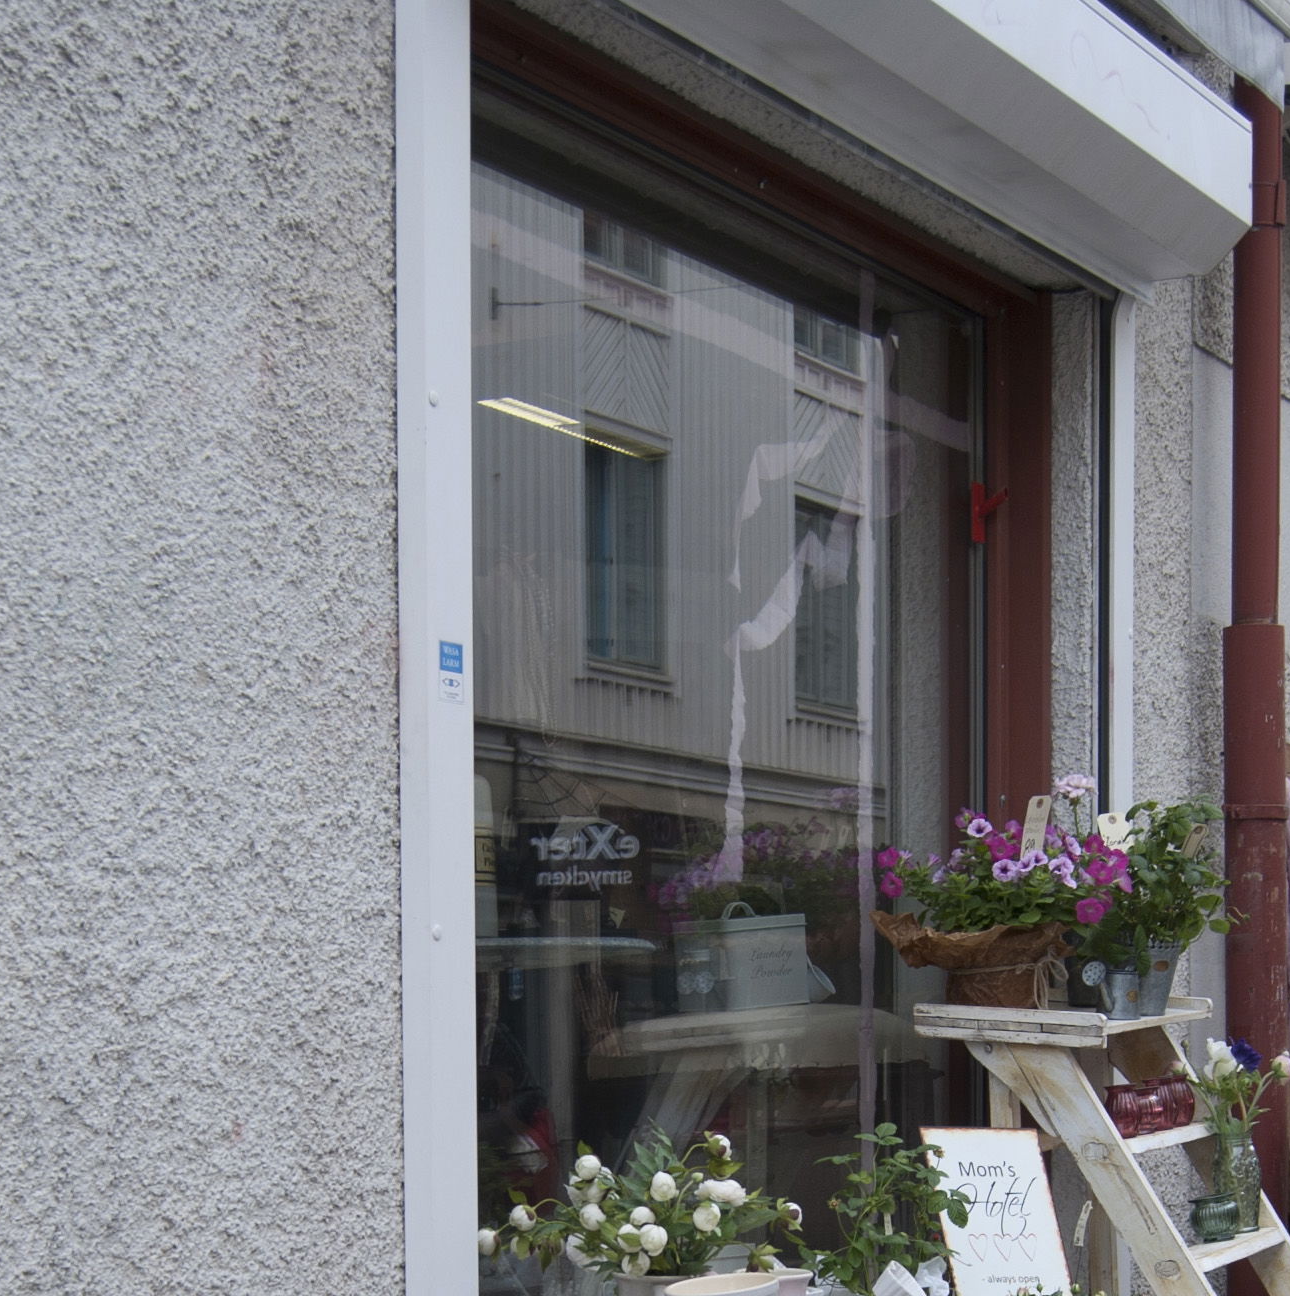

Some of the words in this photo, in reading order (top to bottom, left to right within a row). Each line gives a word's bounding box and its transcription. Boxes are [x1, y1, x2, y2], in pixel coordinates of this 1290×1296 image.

[749, 944, 793, 964] Laundry
[749, 963, 793, 980] Powder
[958, 1161, 1016, 1178] Mom's
[955, 1177, 1037, 1241] Hotel
[987, 1274, 1015, 1285] always
[1018, 1276, 1040, 1285] open
